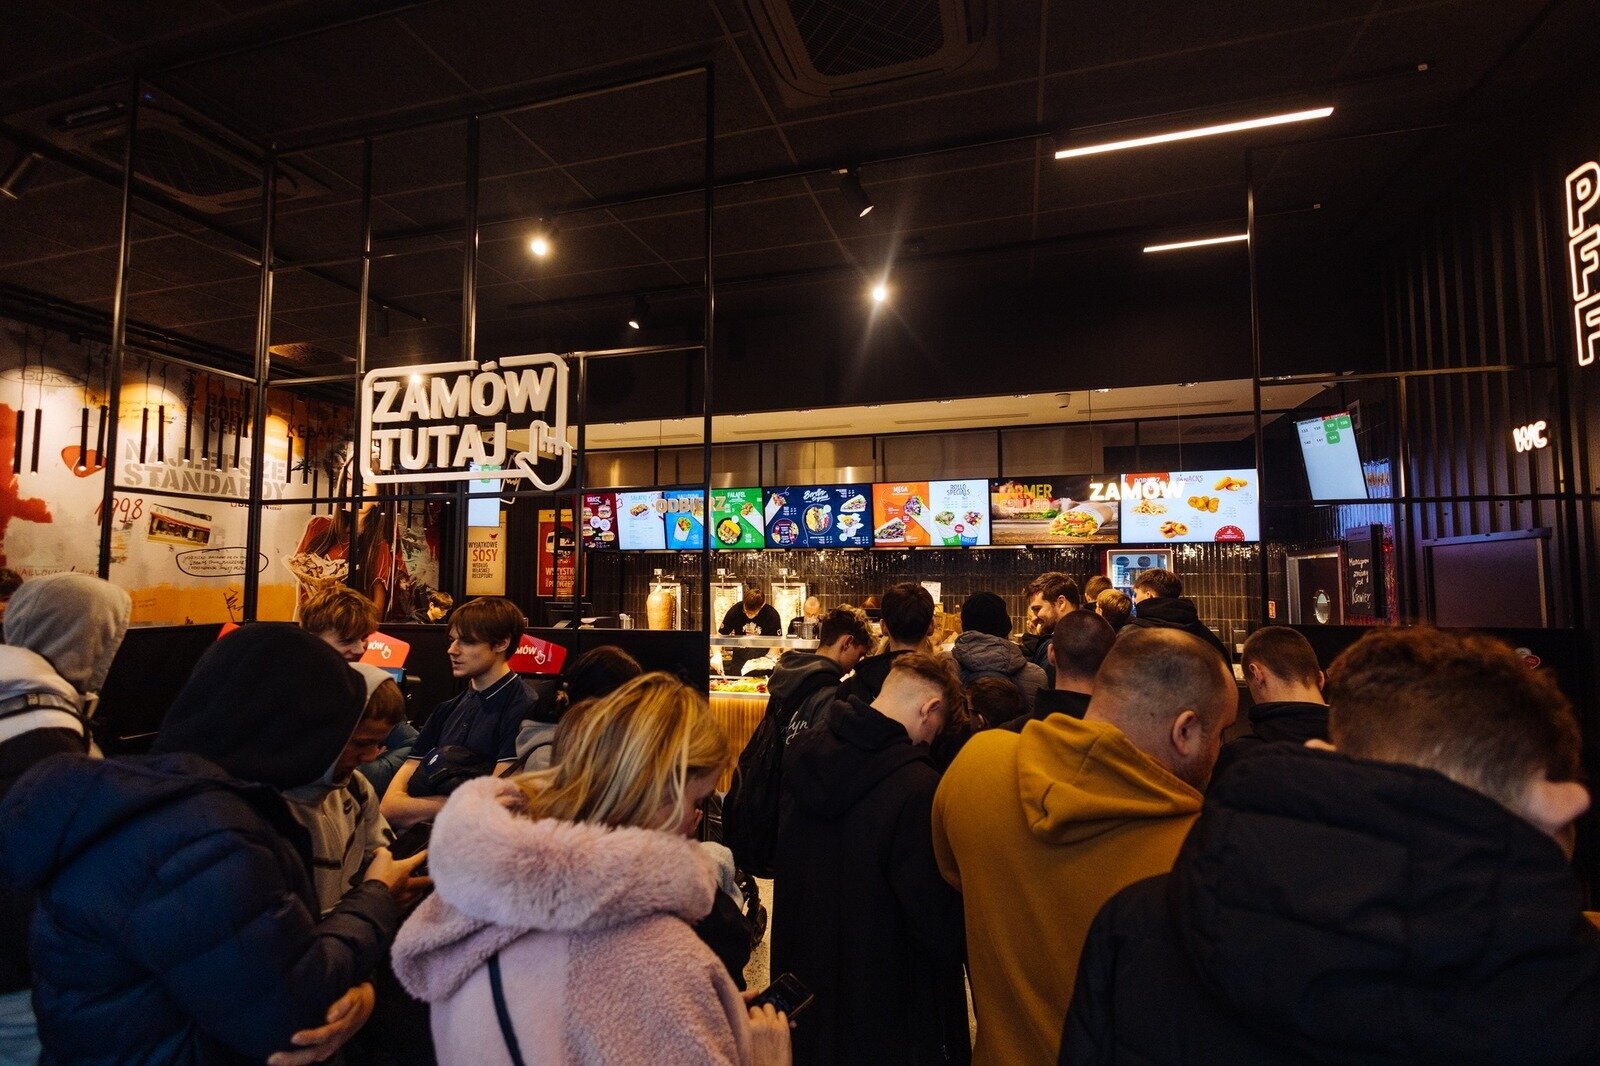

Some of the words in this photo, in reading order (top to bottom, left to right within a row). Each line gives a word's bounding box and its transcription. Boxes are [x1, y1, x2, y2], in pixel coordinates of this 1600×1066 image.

[372, 361, 556, 423] ZAMÓW
[372, 422, 507, 470] TUTAJ
[1512, 421, 1548, 453] WC
[472, 549, 499, 561] SOSY
[515, 644, 537, 655] MÓW
